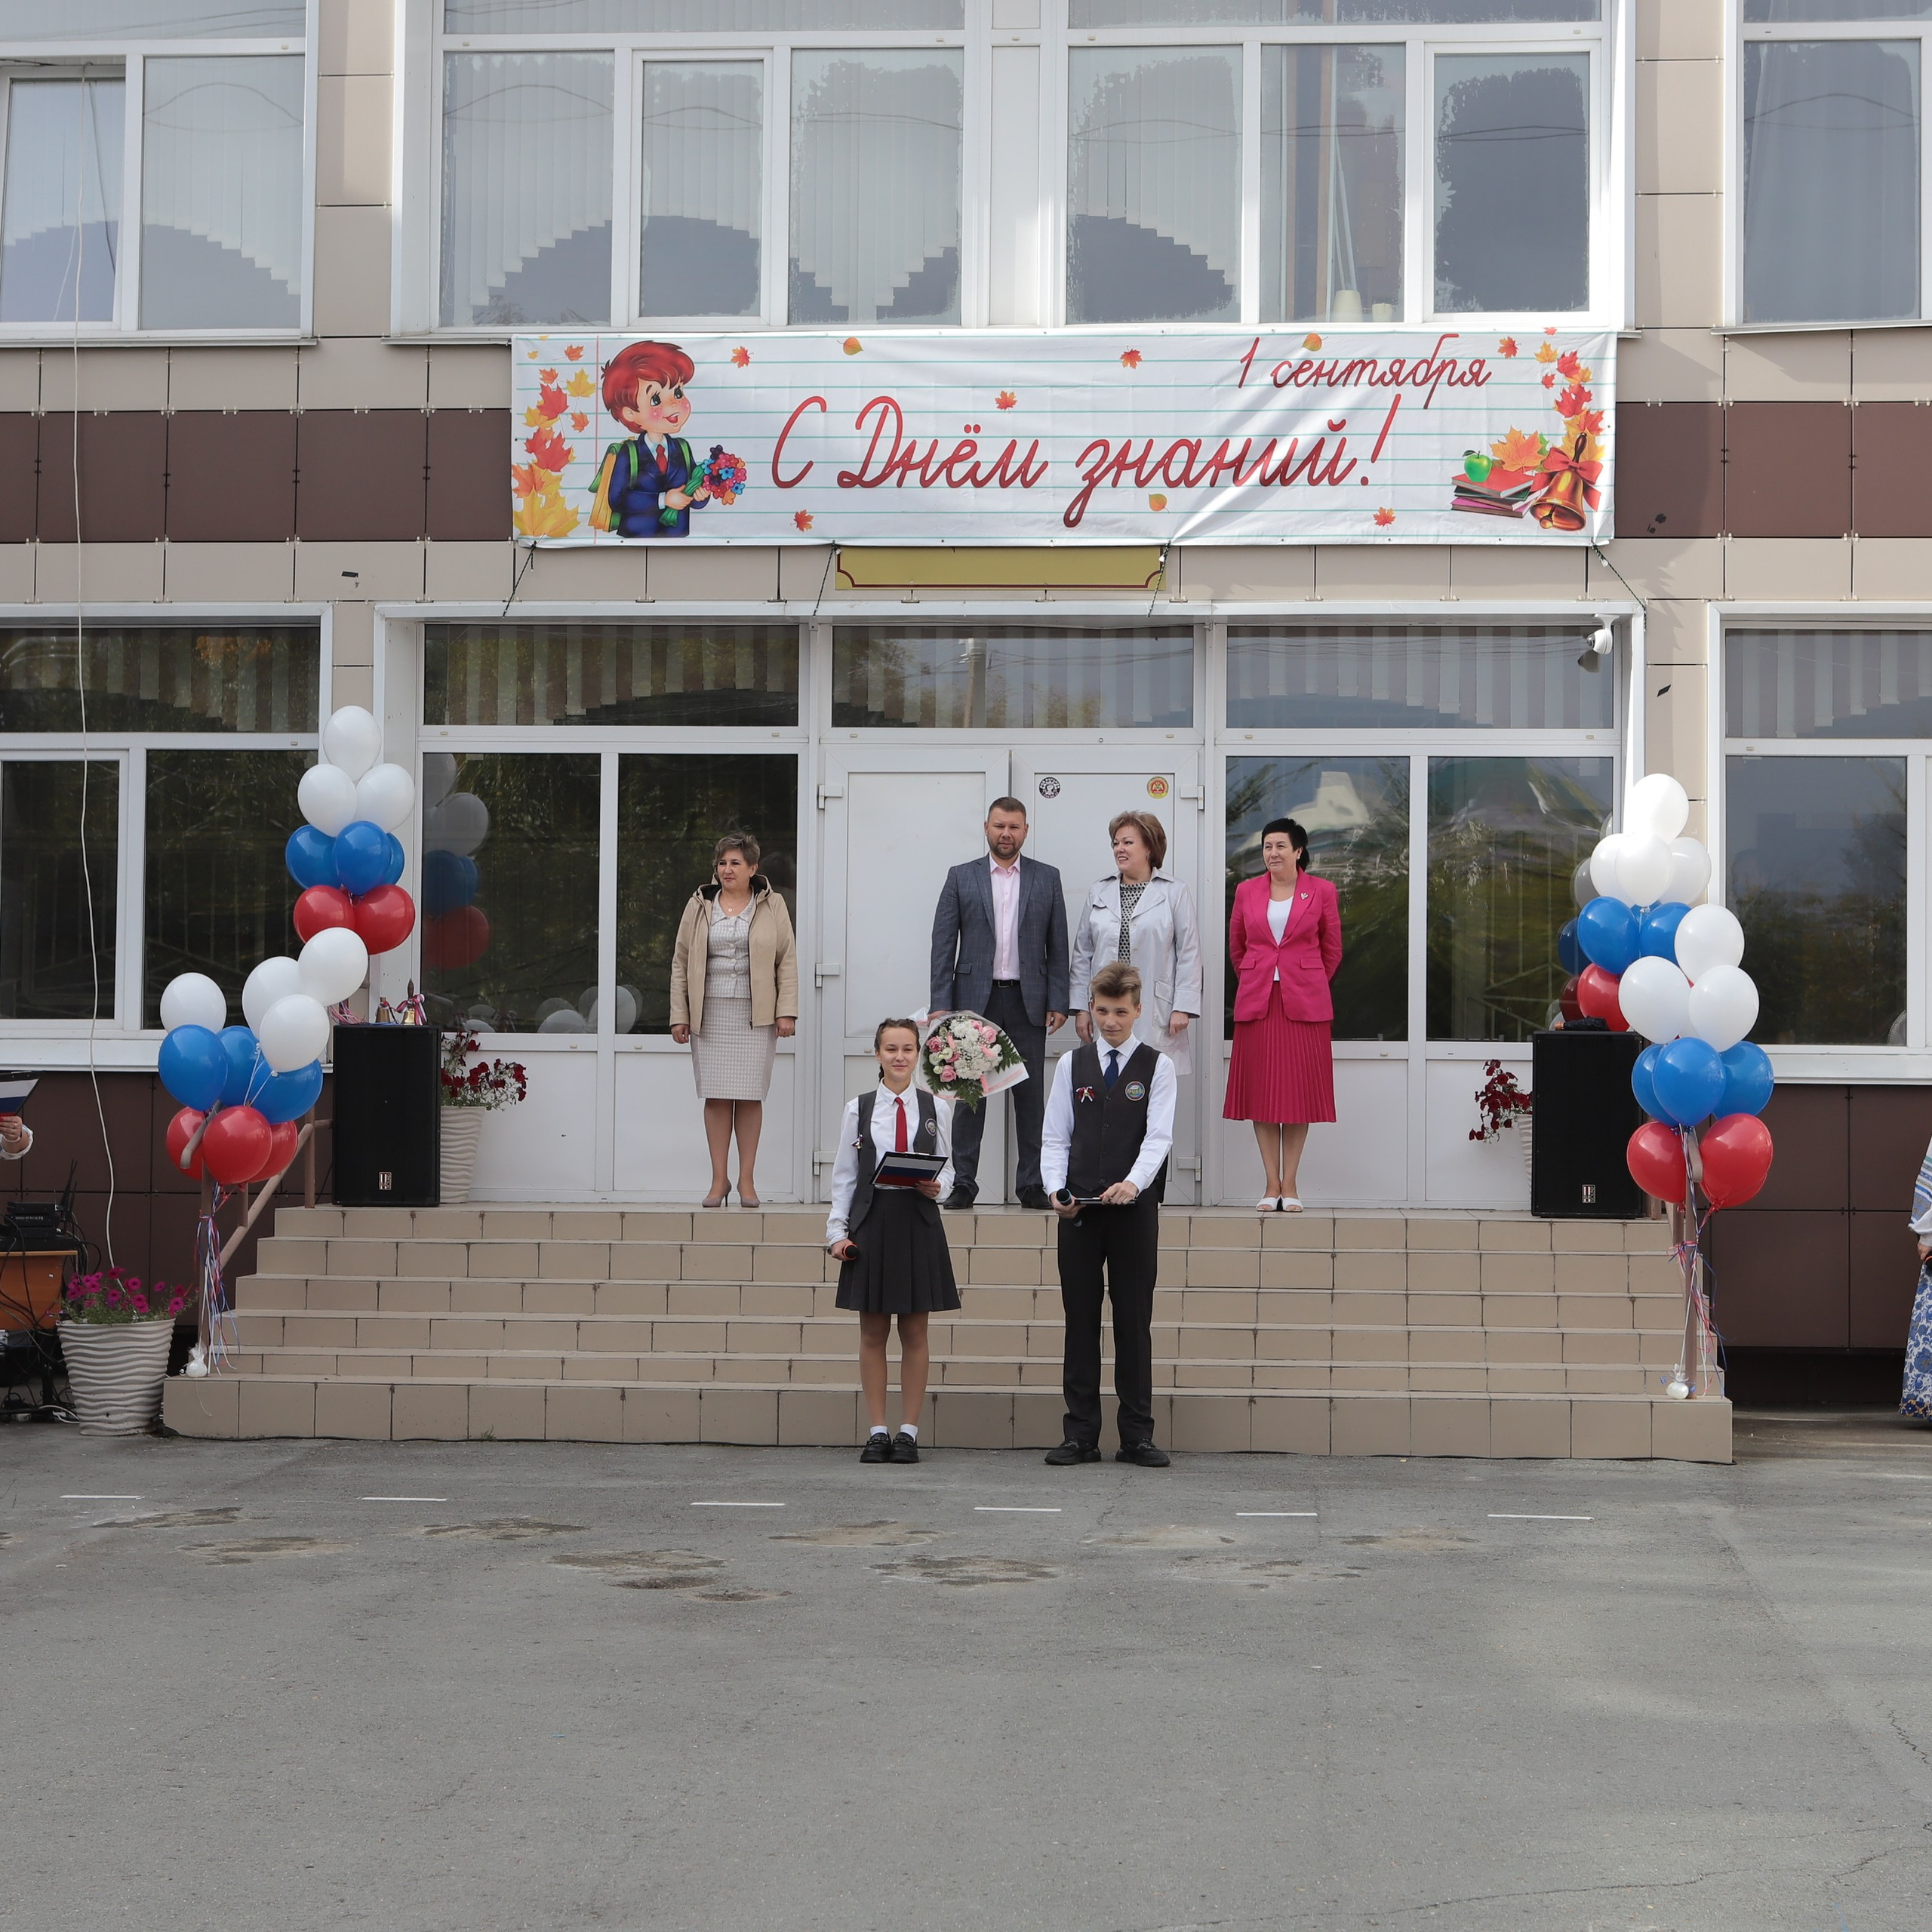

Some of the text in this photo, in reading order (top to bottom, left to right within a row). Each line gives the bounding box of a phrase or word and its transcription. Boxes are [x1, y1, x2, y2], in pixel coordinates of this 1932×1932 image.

[1238, 333, 1492, 410] 1 сентября
[771, 393, 1402, 528] С Днём знаний!
